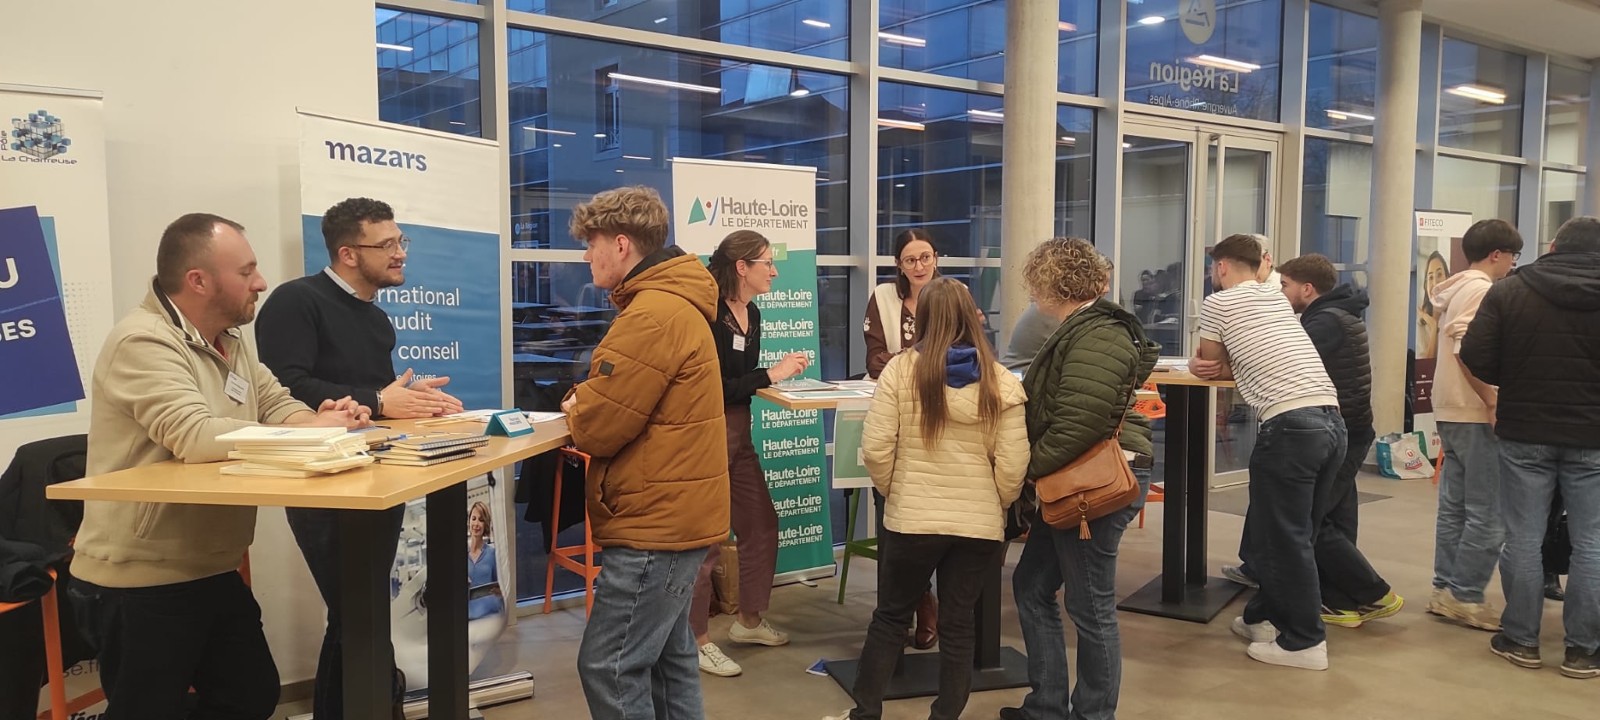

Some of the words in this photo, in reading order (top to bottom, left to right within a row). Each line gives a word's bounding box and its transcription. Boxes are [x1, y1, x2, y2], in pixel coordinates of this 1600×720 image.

[19, 155, 78, 165] Chartreuse
[325, 140, 427, 172] mazars
[721, 196, 809, 218] Haute-Loire
[721, 217, 734, 228] LE
[736, 216, 809, 230] DÉPARTEMENT
[1424, 218, 1444, 227] FITECO
[377, 286, 460, 306] rnational
[756, 289, 813, 301] Haute-Loire
[767, 300, 813, 309] DÉPARTEMENT
[387, 311, 433, 331] udit
[0, 319, 37, 341] ES
[768, 330, 814, 339] DÉPARTEMENT
[398, 341, 460, 360] conseil
[761, 408, 818, 421] Haute-Loire
[762, 421, 771, 429] LE
[772, 418, 818, 428] DÉPARTEMENT
[762, 436, 820, 451] Haute-Loire
[773, 446, 820, 458] DÉPARTEMENT
[764, 465, 821, 481] Haute-Loire
[774, 476, 820, 488] DÉPARTEMENT
[771, 494, 822, 511] aute-Loire
